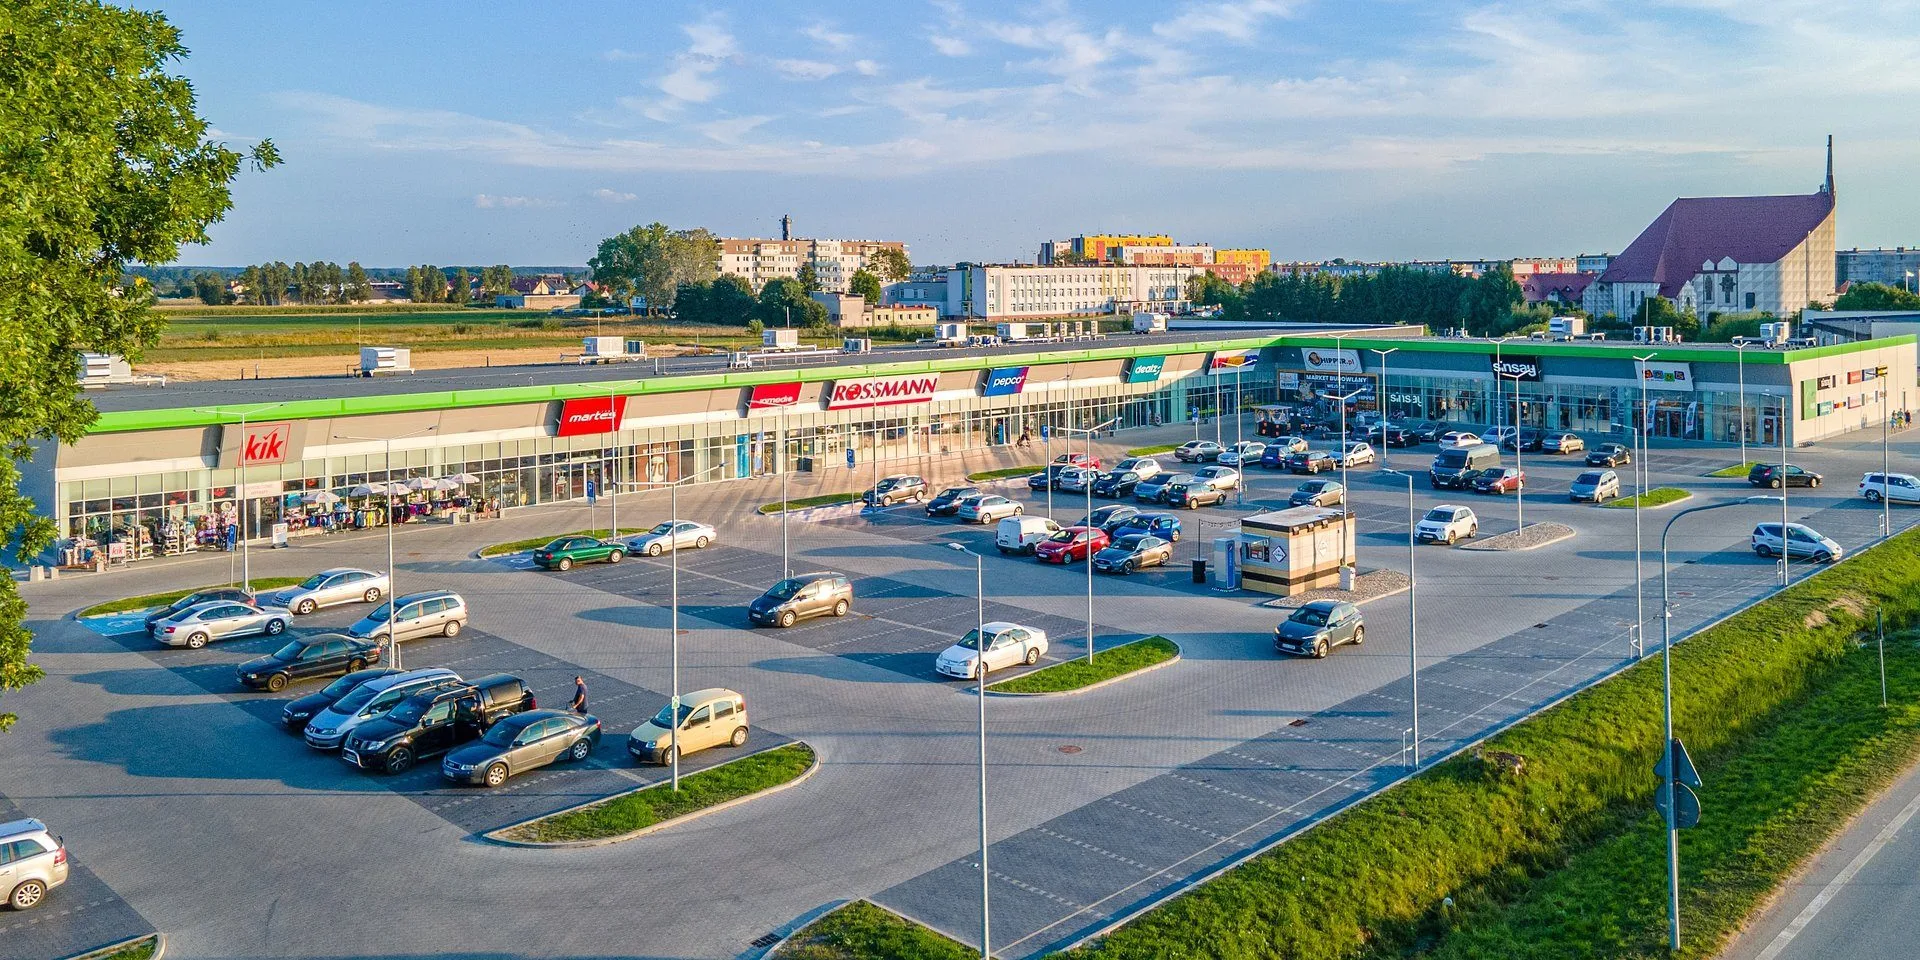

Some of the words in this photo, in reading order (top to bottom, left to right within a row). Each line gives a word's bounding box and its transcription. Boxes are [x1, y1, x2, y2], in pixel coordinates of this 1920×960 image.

[1135, 364, 1161, 375] dealz
[1493, 361, 1536, 376] sinsay
[993, 376, 1022, 387] pepco
[833, 378, 937, 401] ROSSMANN
[1390, 392, 1422, 407] sinsay
[569, 411, 616, 423] martes
[245, 430, 283, 460] kik
